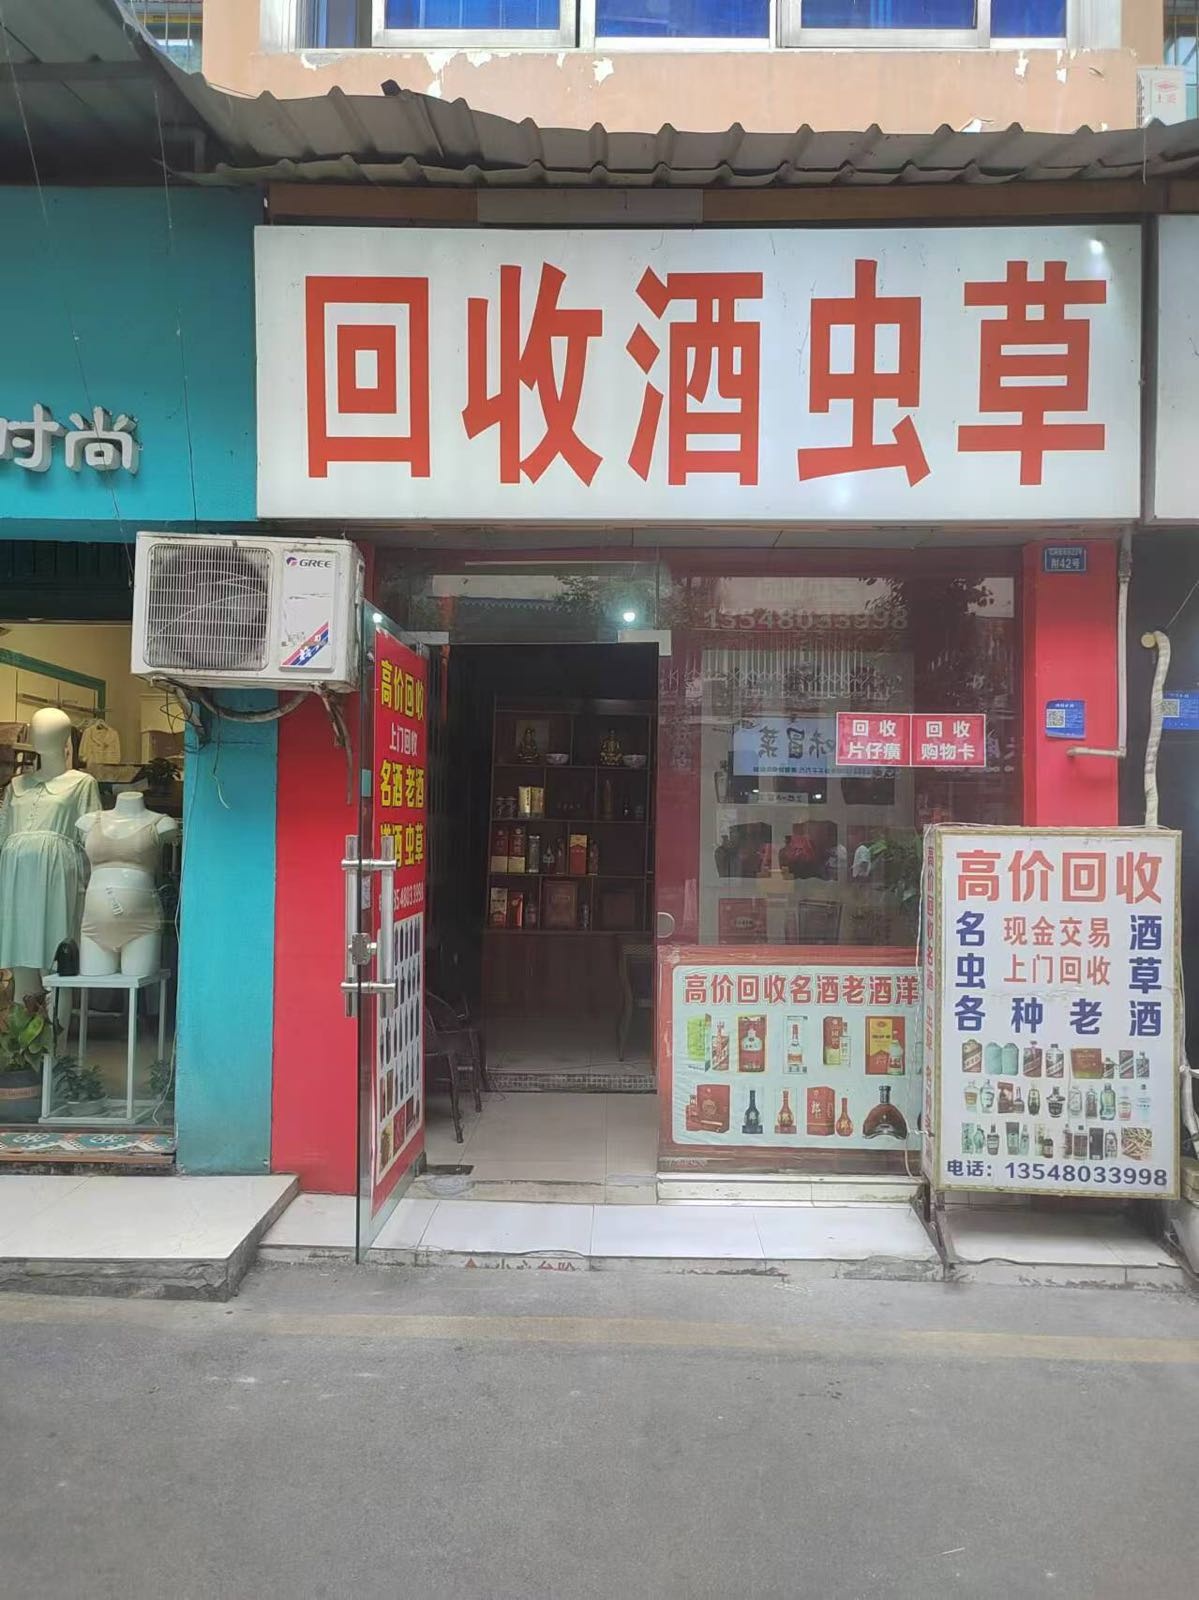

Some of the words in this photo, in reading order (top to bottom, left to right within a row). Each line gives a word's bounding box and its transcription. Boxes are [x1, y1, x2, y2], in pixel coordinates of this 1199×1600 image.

[305, 258, 1108, 489] 回收酒虫草
[0, 401, 140, 474] 时尚
[299, 559, 333, 568] GREE
[380, 659, 425, 721] 高价回收
[389, 721, 418, 757] 上门回收
[852, 720, 896, 737] 回收
[925, 720, 970, 738] 回收
[921, 743, 976, 762] 购物卡
[380, 759, 403, 807] 名酒
[405, 764, 425, 808] 老酒
[405, 823, 424, 866] 虫草
[956, 850, 1162, 904] 高价回收
[1003, 915, 1110, 948] 现金交易
[1003, 953, 1110, 986] 上门回收
[684, 973, 920, 1006] 高价回收名酒老酒洋
[954, 995, 1162, 1037] 各种老酒
[1005, 1162, 1167, 1187] 13548033998
